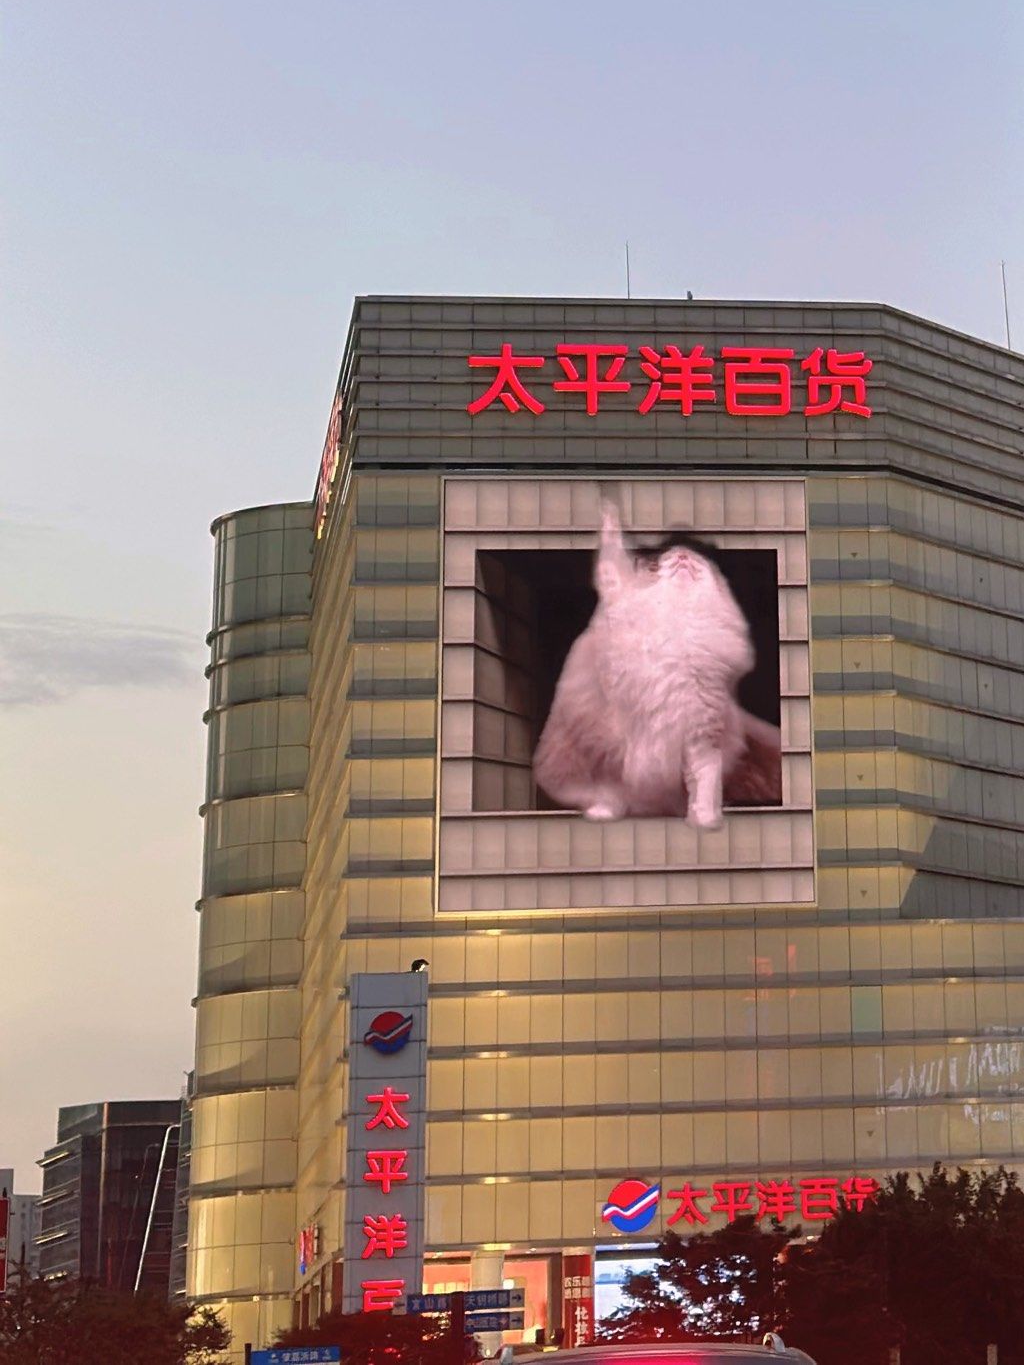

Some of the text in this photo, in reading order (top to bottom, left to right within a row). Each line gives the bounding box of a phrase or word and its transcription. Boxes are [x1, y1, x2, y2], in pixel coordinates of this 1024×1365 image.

[467, 343, 874, 419] 太平洋百货
